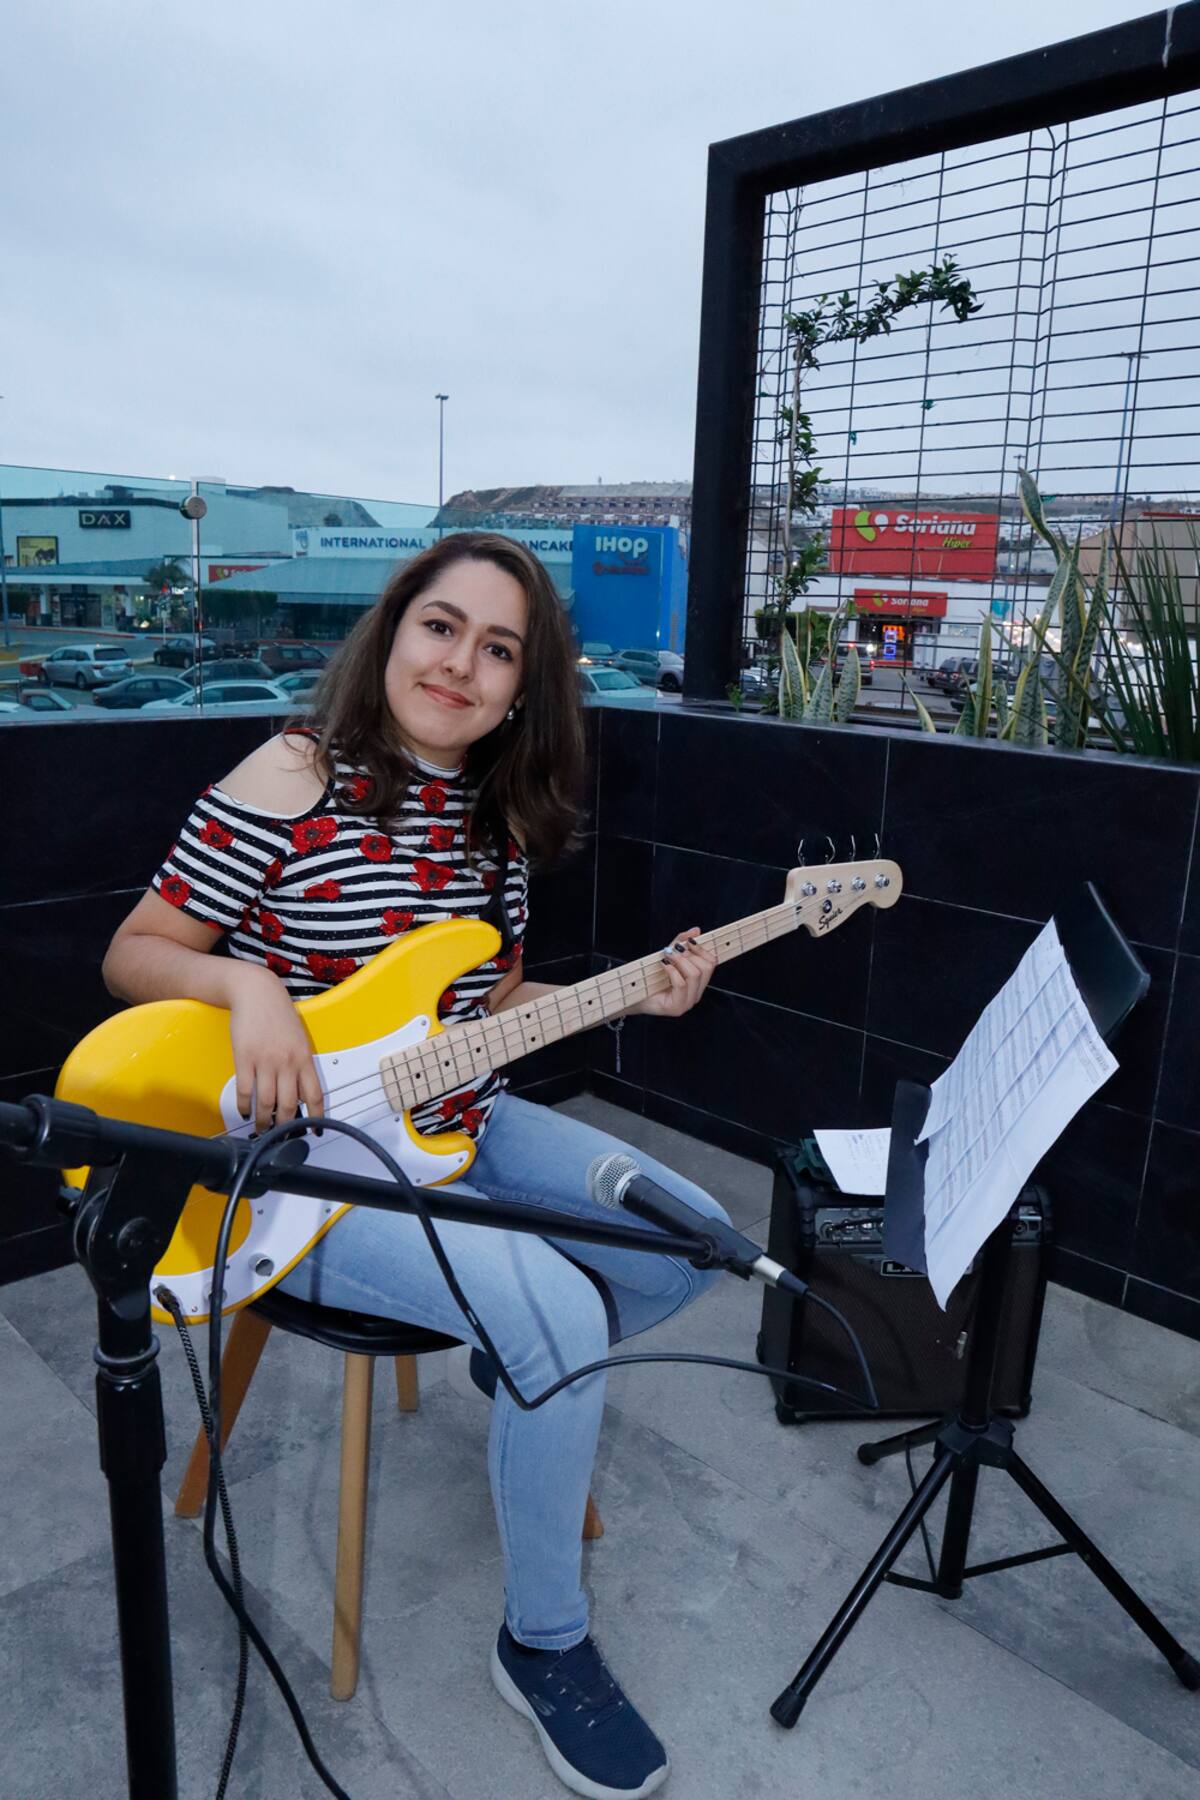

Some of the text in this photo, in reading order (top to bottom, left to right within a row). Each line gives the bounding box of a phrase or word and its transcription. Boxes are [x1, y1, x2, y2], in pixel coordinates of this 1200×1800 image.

[81, 513, 126, 525] DAX
[894, 514, 976, 535] Soriana
[320, 537, 427, 549] INTERNATIONAL
[942, 537, 971, 548] Hiper
